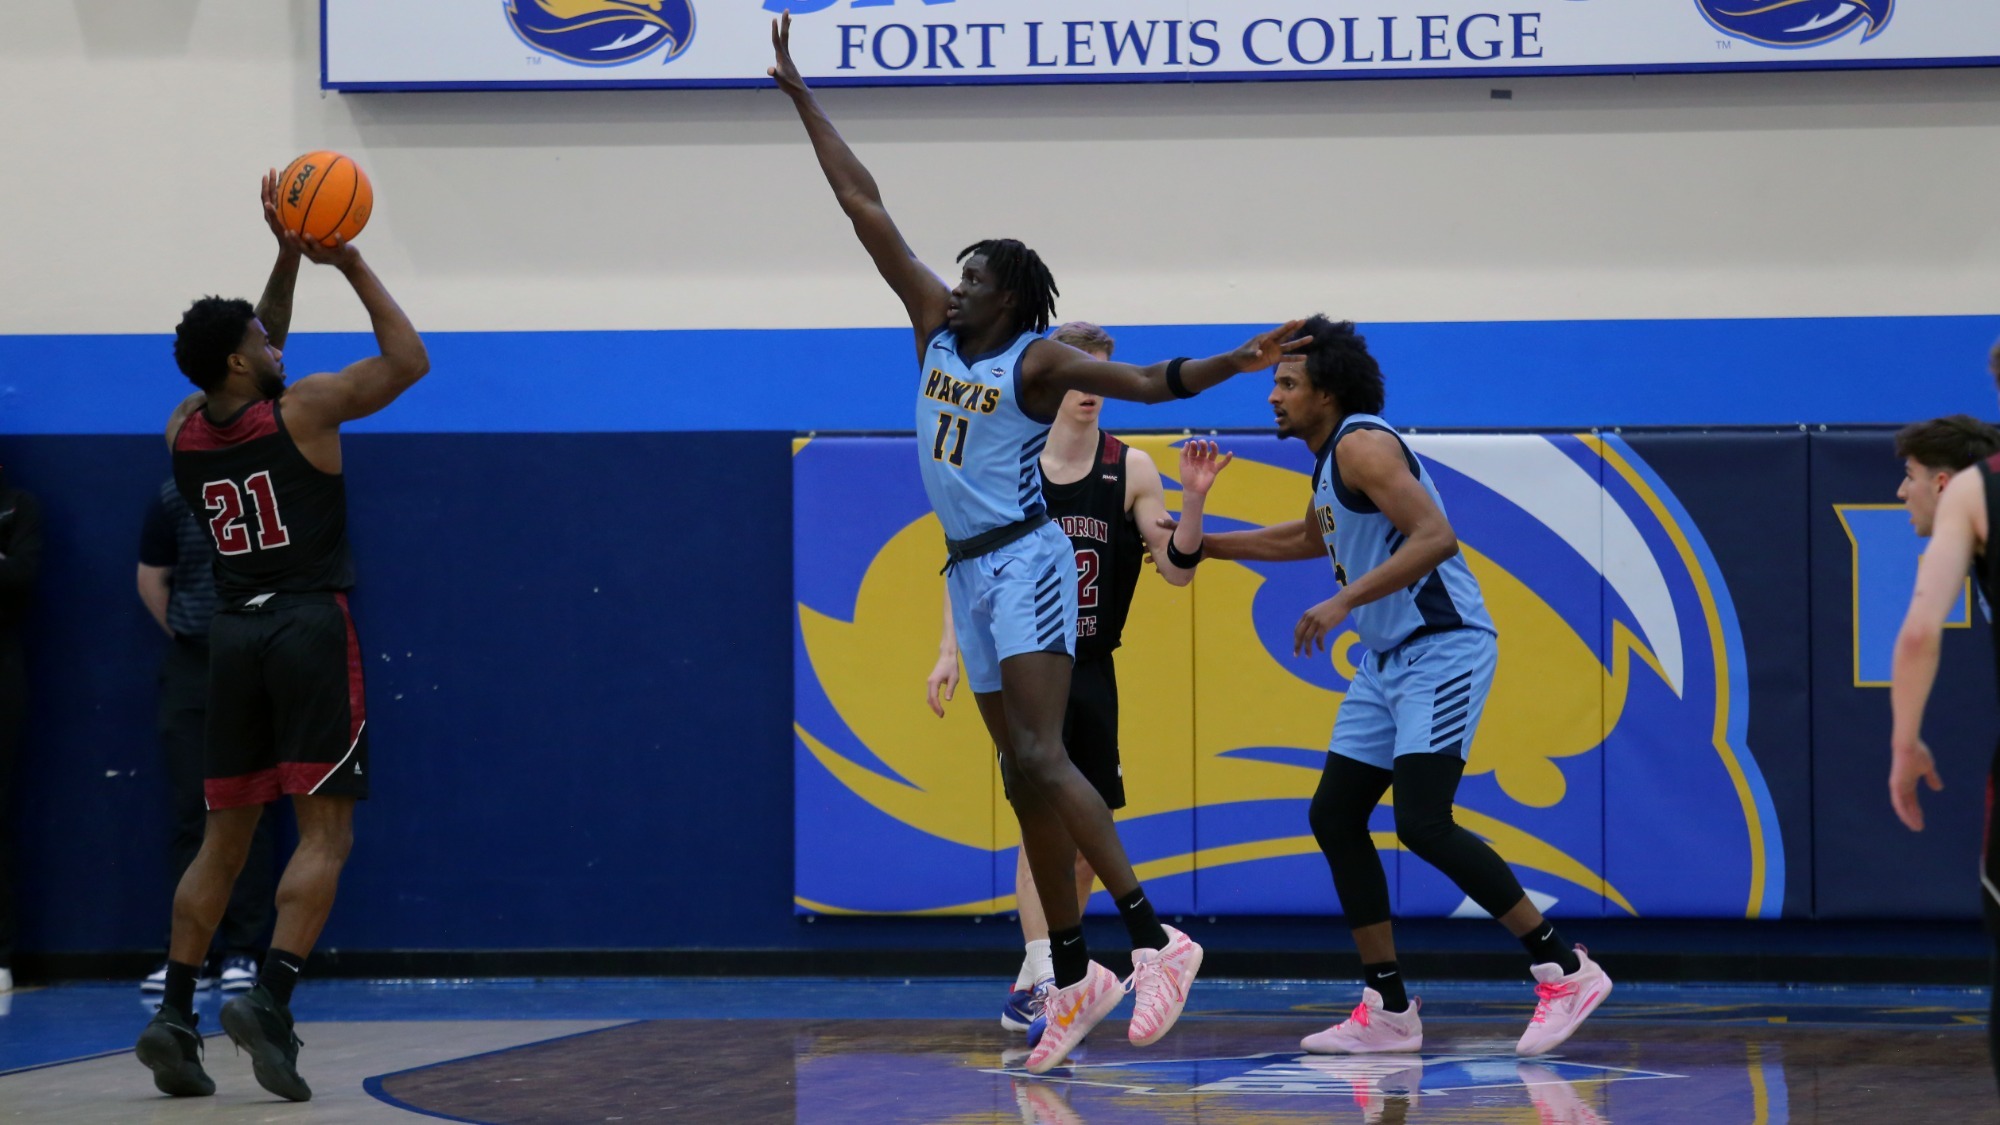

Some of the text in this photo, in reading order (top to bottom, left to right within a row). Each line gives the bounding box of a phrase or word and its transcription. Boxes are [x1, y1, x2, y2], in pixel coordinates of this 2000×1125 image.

[525, 56, 542, 65] TM
[836, 12, 1544, 71] FORT LEWIS COLLEGE
[1716, 40, 1731, 49] TM
[287, 163, 316, 208] NCAA
[924, 368, 1001, 415] HAWKS
[933, 411, 969, 469] 11
[202, 470, 291, 556] 21
[1051, 516, 1108, 543] DRON
